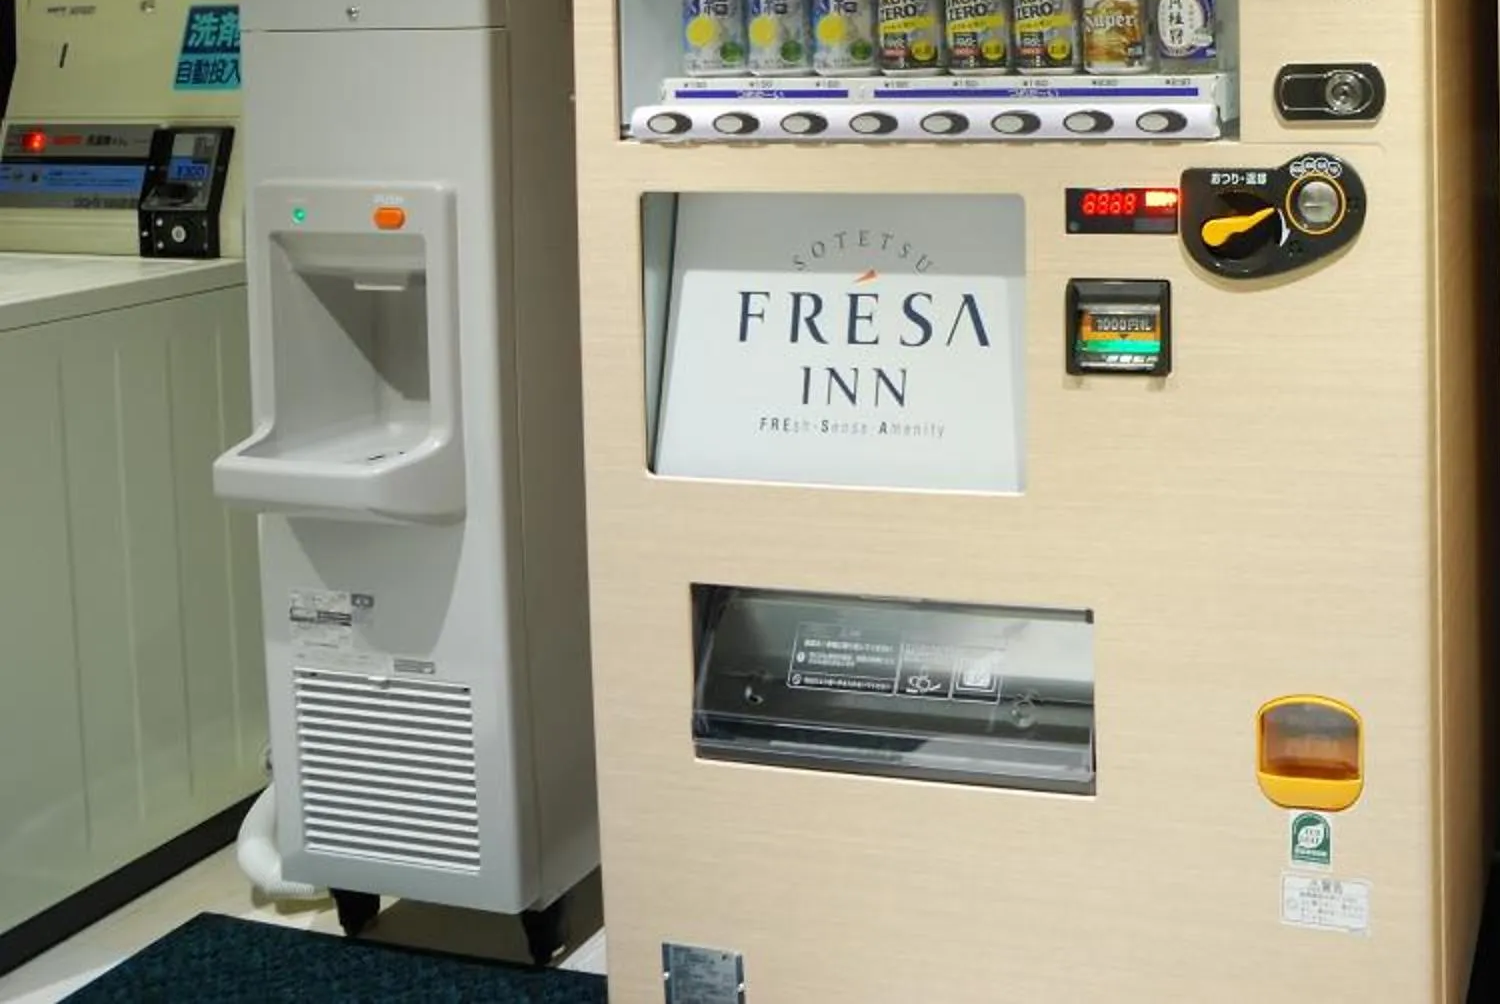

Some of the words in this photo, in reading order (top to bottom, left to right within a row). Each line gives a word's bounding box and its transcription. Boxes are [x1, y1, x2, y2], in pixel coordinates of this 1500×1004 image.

[189, 11, 240, 47] 洗剤
[175, 58, 241, 86] 自動投入
[792, 229, 934, 273] SOTETSU
[799, 365, 908, 408] INN
